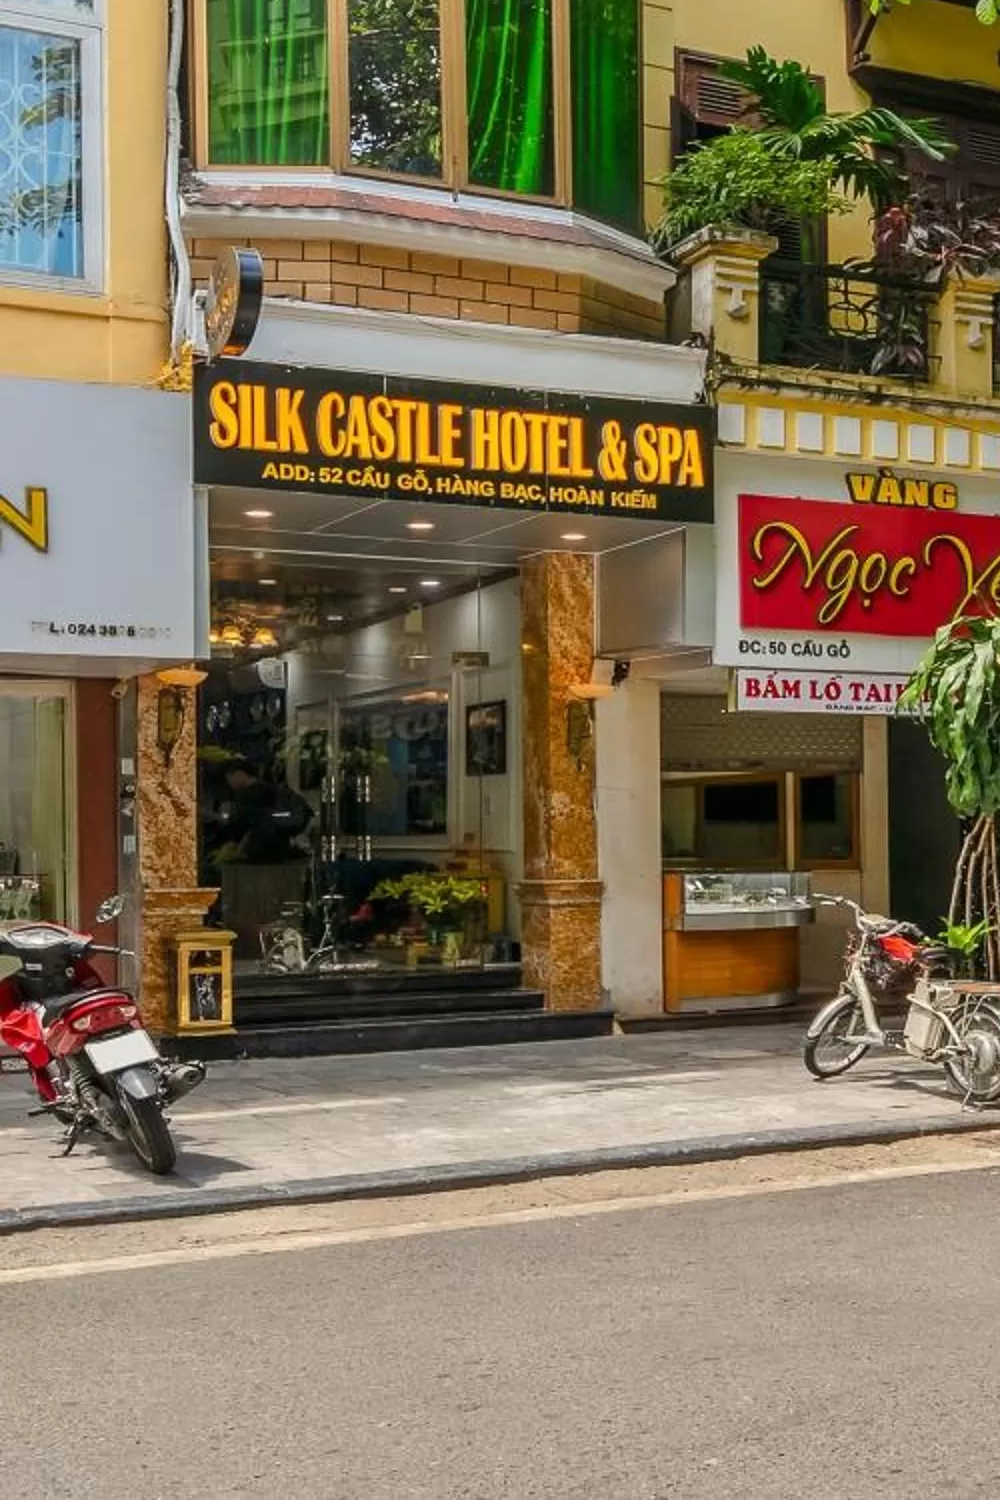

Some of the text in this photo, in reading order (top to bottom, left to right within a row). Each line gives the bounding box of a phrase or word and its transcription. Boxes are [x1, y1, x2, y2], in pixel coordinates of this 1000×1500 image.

[209, 380, 705, 488] SILK CASTLE HOTEL & SPA
[261, 461, 316, 483] ADD:
[319, 467, 343, 484] 52
[436, 473, 496, 497] HÀNG
[500, 482, 547, 504] BẠC,
[549, 484, 605, 506] HOÀN
[611, 489, 657, 509] KIẾM
[847, 467, 959, 510] VÀNG
[753, 521, 916, 624] Ngọc
[768, 641, 787, 656] 50
[745, 670, 801, 699] BẤM
[809, 675, 843, 701] LỖ
